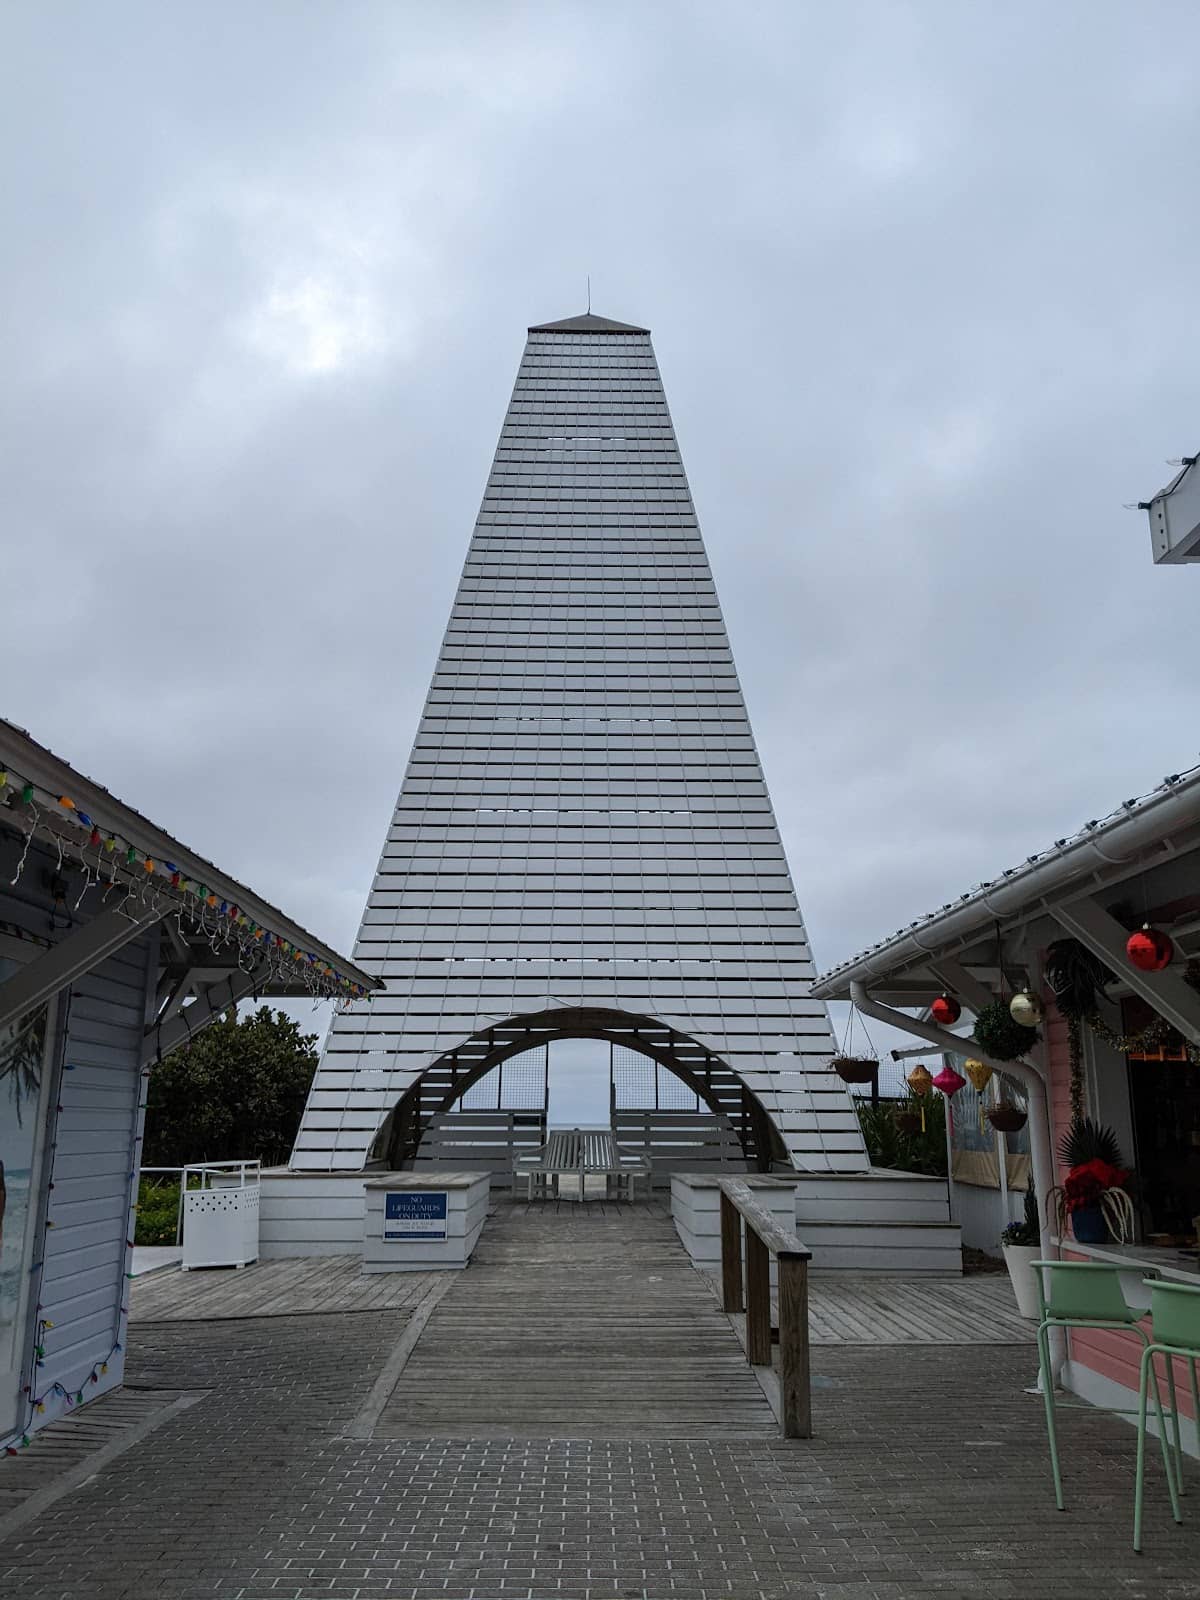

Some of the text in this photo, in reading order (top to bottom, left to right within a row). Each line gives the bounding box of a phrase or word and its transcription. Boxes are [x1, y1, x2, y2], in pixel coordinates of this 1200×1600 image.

[410, 1196, 423, 1204] NO
[392, 1204, 441, 1212] LIFEGUARDS
[398, 1212, 433, 1220] ON DUTY
